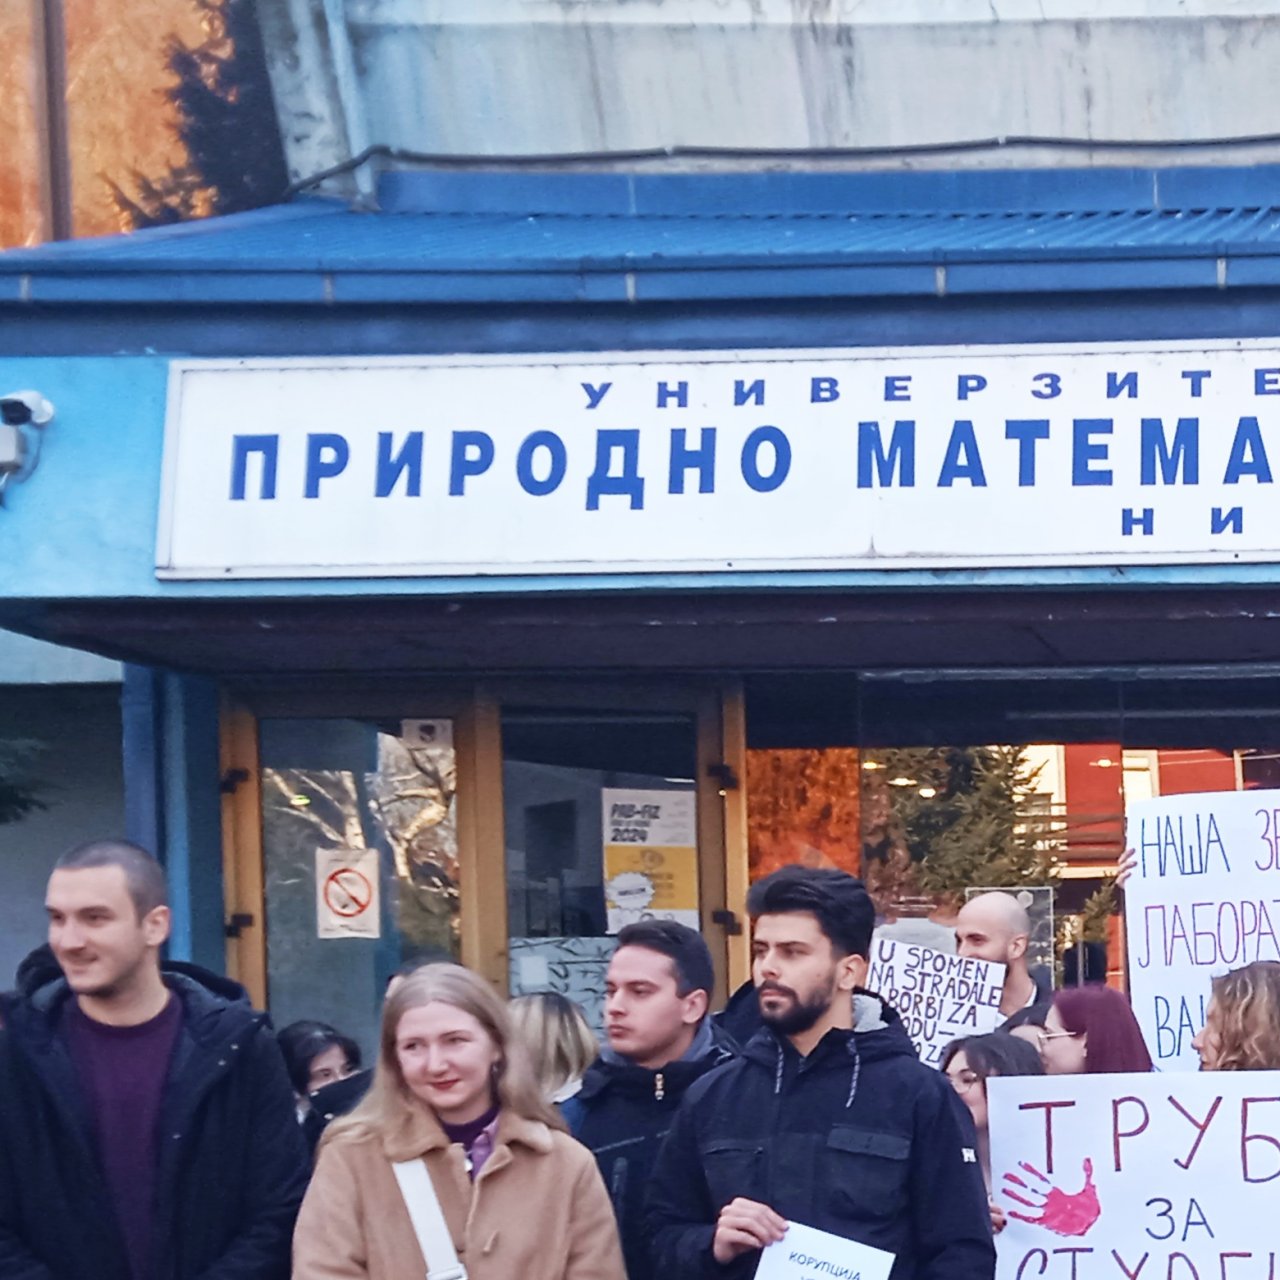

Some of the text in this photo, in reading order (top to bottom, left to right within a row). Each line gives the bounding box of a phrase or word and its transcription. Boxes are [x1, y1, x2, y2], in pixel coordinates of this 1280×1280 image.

[229, 424, 791, 510] ПРИРОДНО
[1140, 813, 1231, 878] НАША
[878, 939, 989, 982] U SPOMEN
[868, 962, 1004, 1008] NA STRADALE
[946, 1001, 978, 1028] ZA
[1144, 1197, 1215, 1242] ЗА
